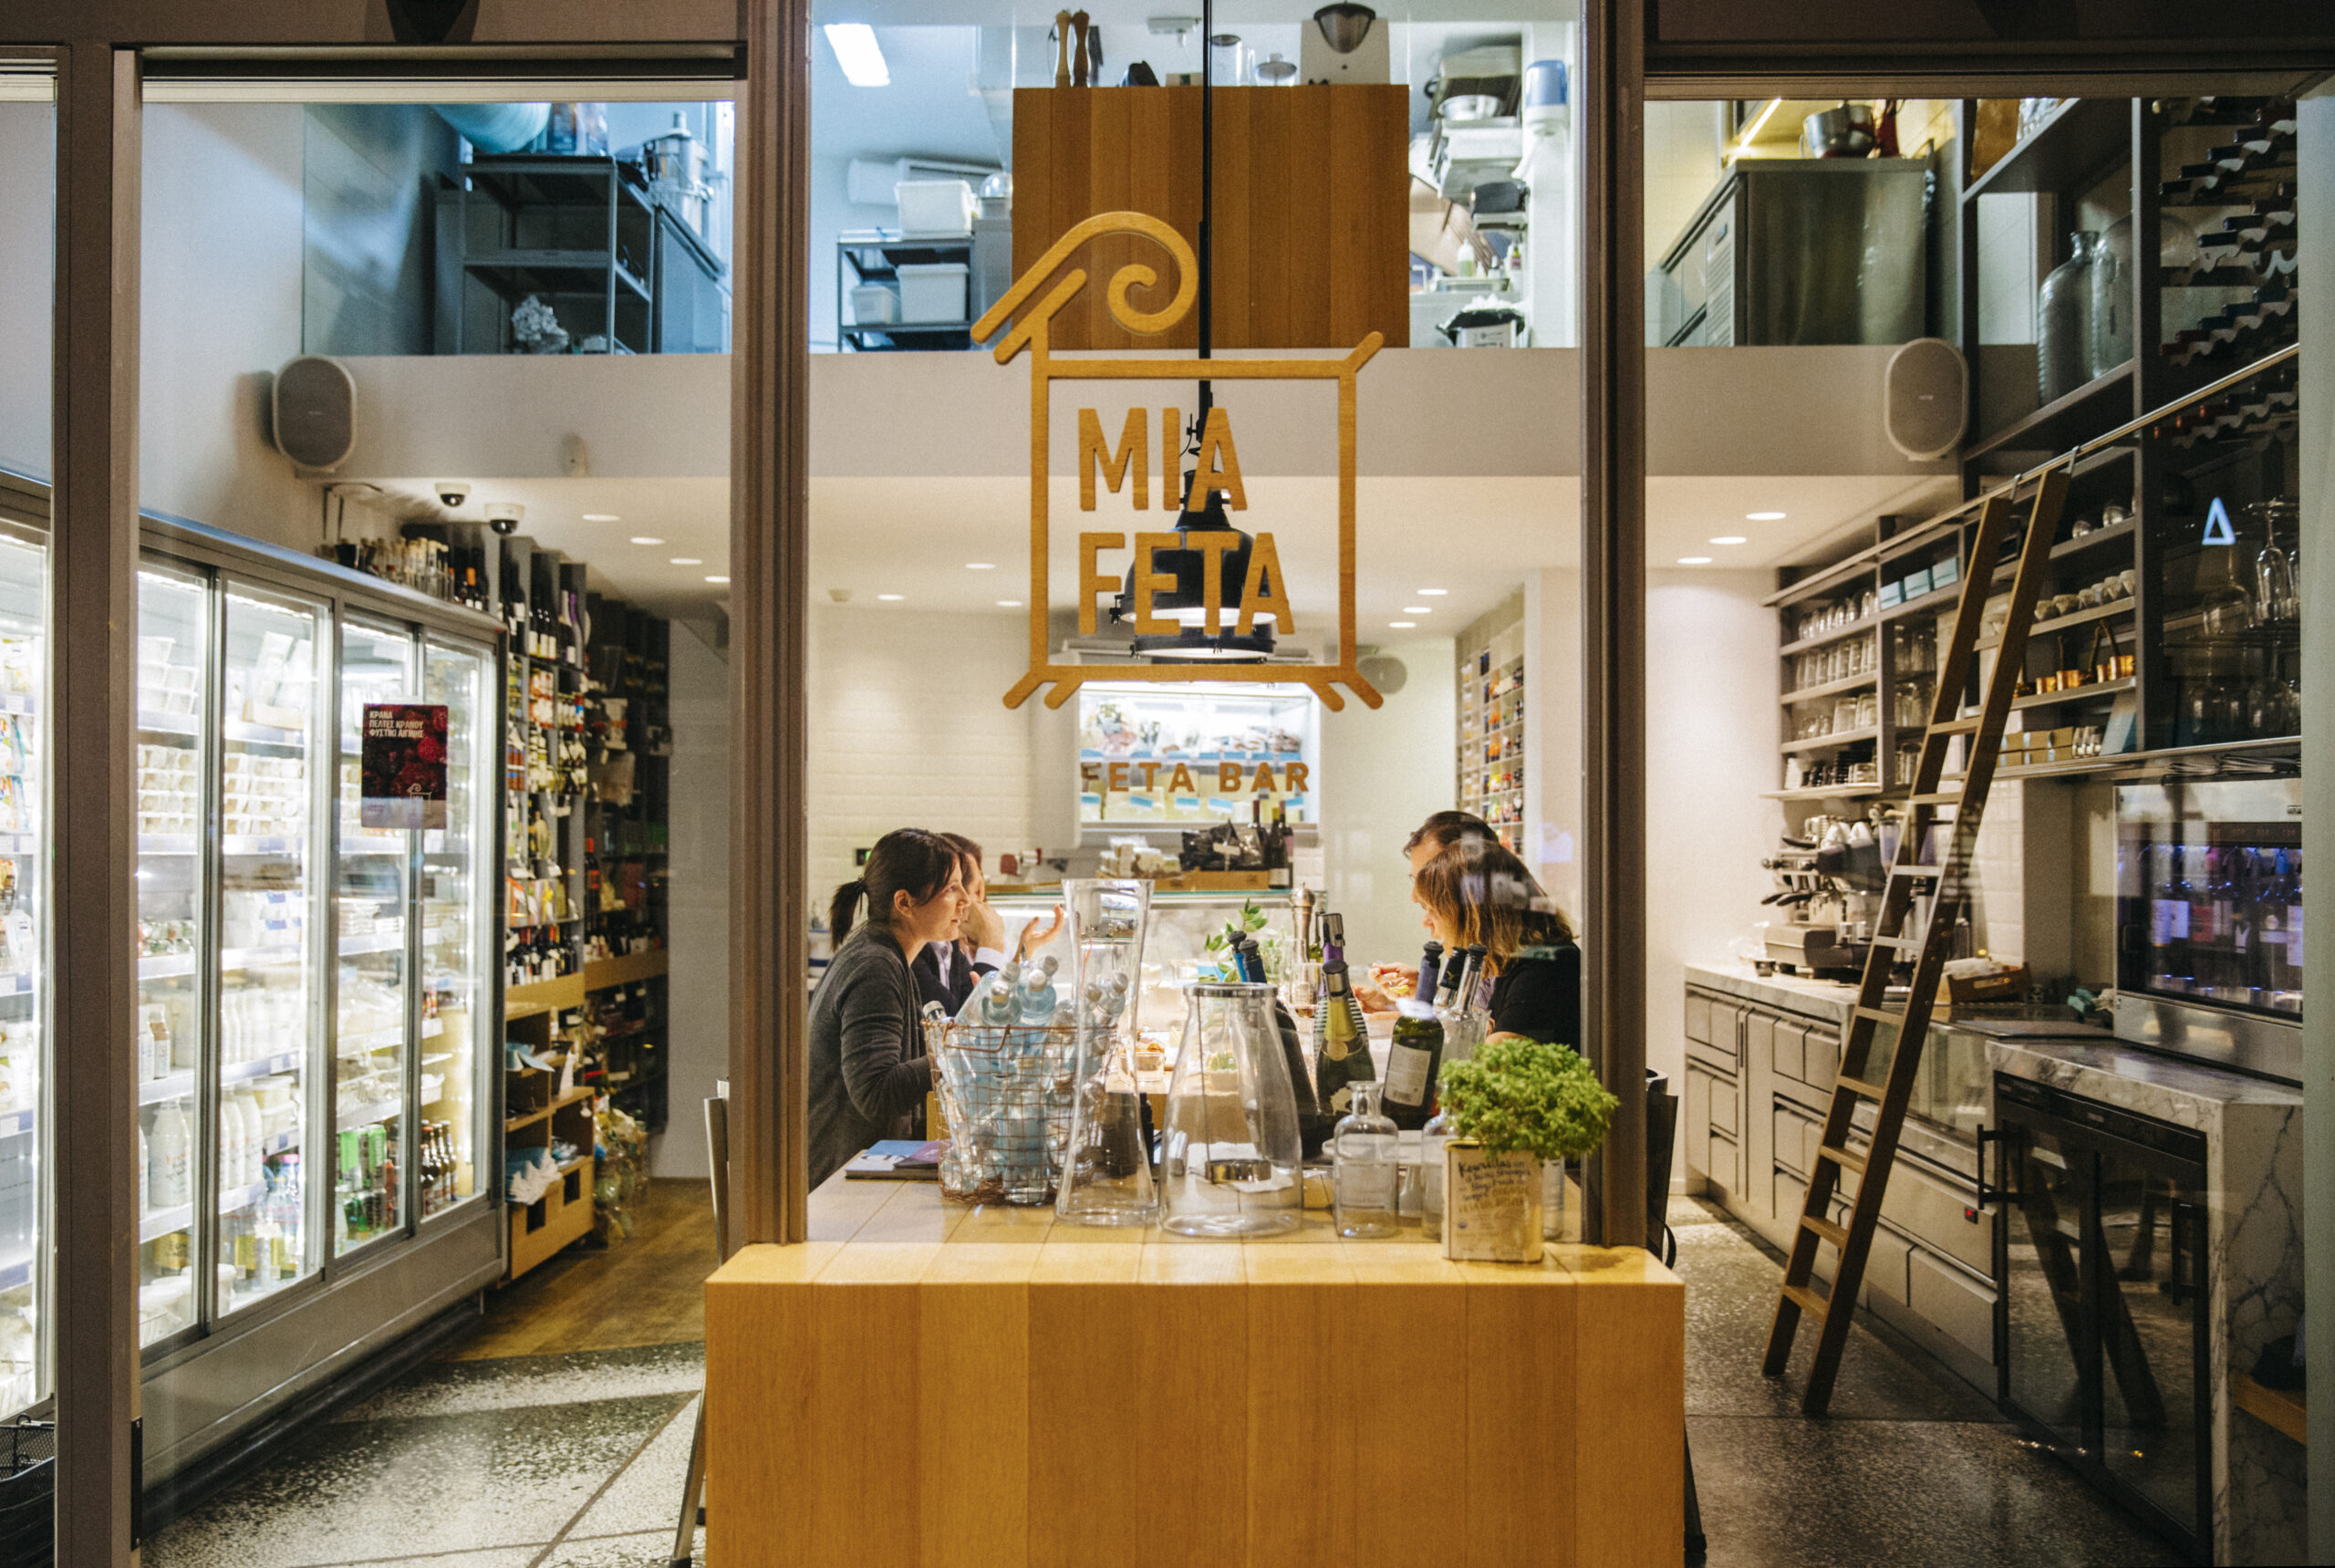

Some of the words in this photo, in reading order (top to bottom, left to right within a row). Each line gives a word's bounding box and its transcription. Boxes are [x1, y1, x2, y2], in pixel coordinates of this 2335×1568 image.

[1079, 407, 1248, 512] MIA
[1078, 532, 1295, 635] FETA
[1081, 763, 1195, 792] FETA
[1219, 763, 1309, 792] BAR
